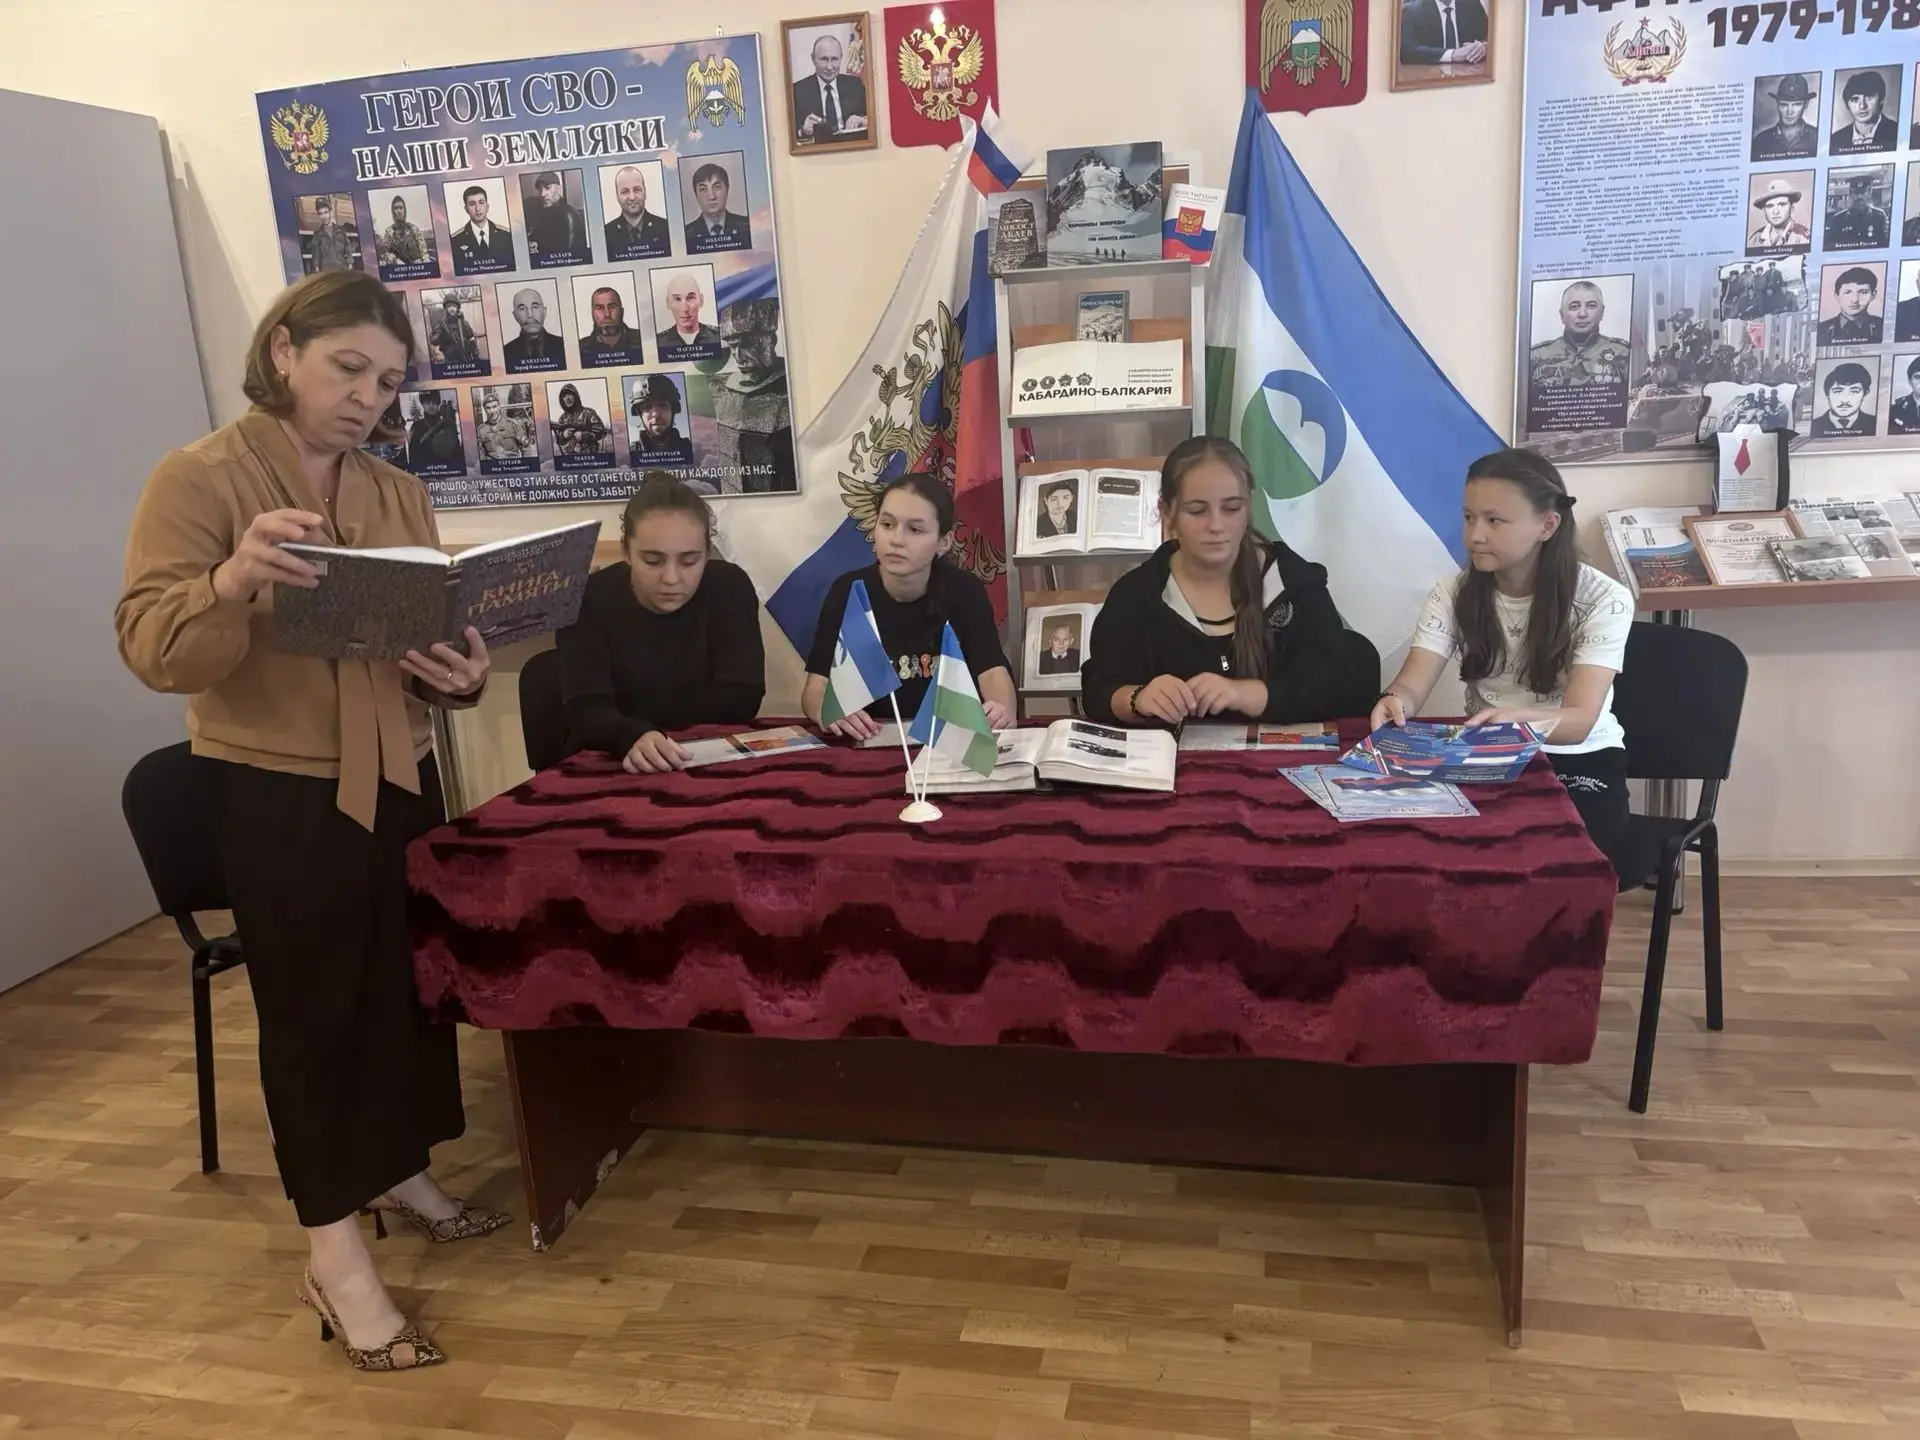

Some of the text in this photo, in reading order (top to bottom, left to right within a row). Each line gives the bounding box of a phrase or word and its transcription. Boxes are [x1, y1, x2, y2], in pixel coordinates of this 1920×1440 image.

[361, 78, 516, 134] ГЕРОИ
[521, 67, 618, 116] СВО
[353, 117, 668, 180] НАШИ ЗЕМЛЯКИ
[1019, 386, 1172, 402] КАБАРДИНО-БАЛКАРИЯ
[524, 476, 548, 486] ЭТИХ
[550, 474, 579, 486] РЕБЯТ
[581, 471, 637, 484] ОСТАНЕТСЯ
[688, 466, 736, 479] КАЖДОГО
[738, 465, 751, 476] ИЗ
[753, 464, 776, 475] НАС.
[470, 491, 514, 504] ИСТОРИИ
[515, 490, 527, 501] НЕ
[528, 488, 570, 502] ДОЛЖНО
[572, 487, 599, 499] БЫТЬ
